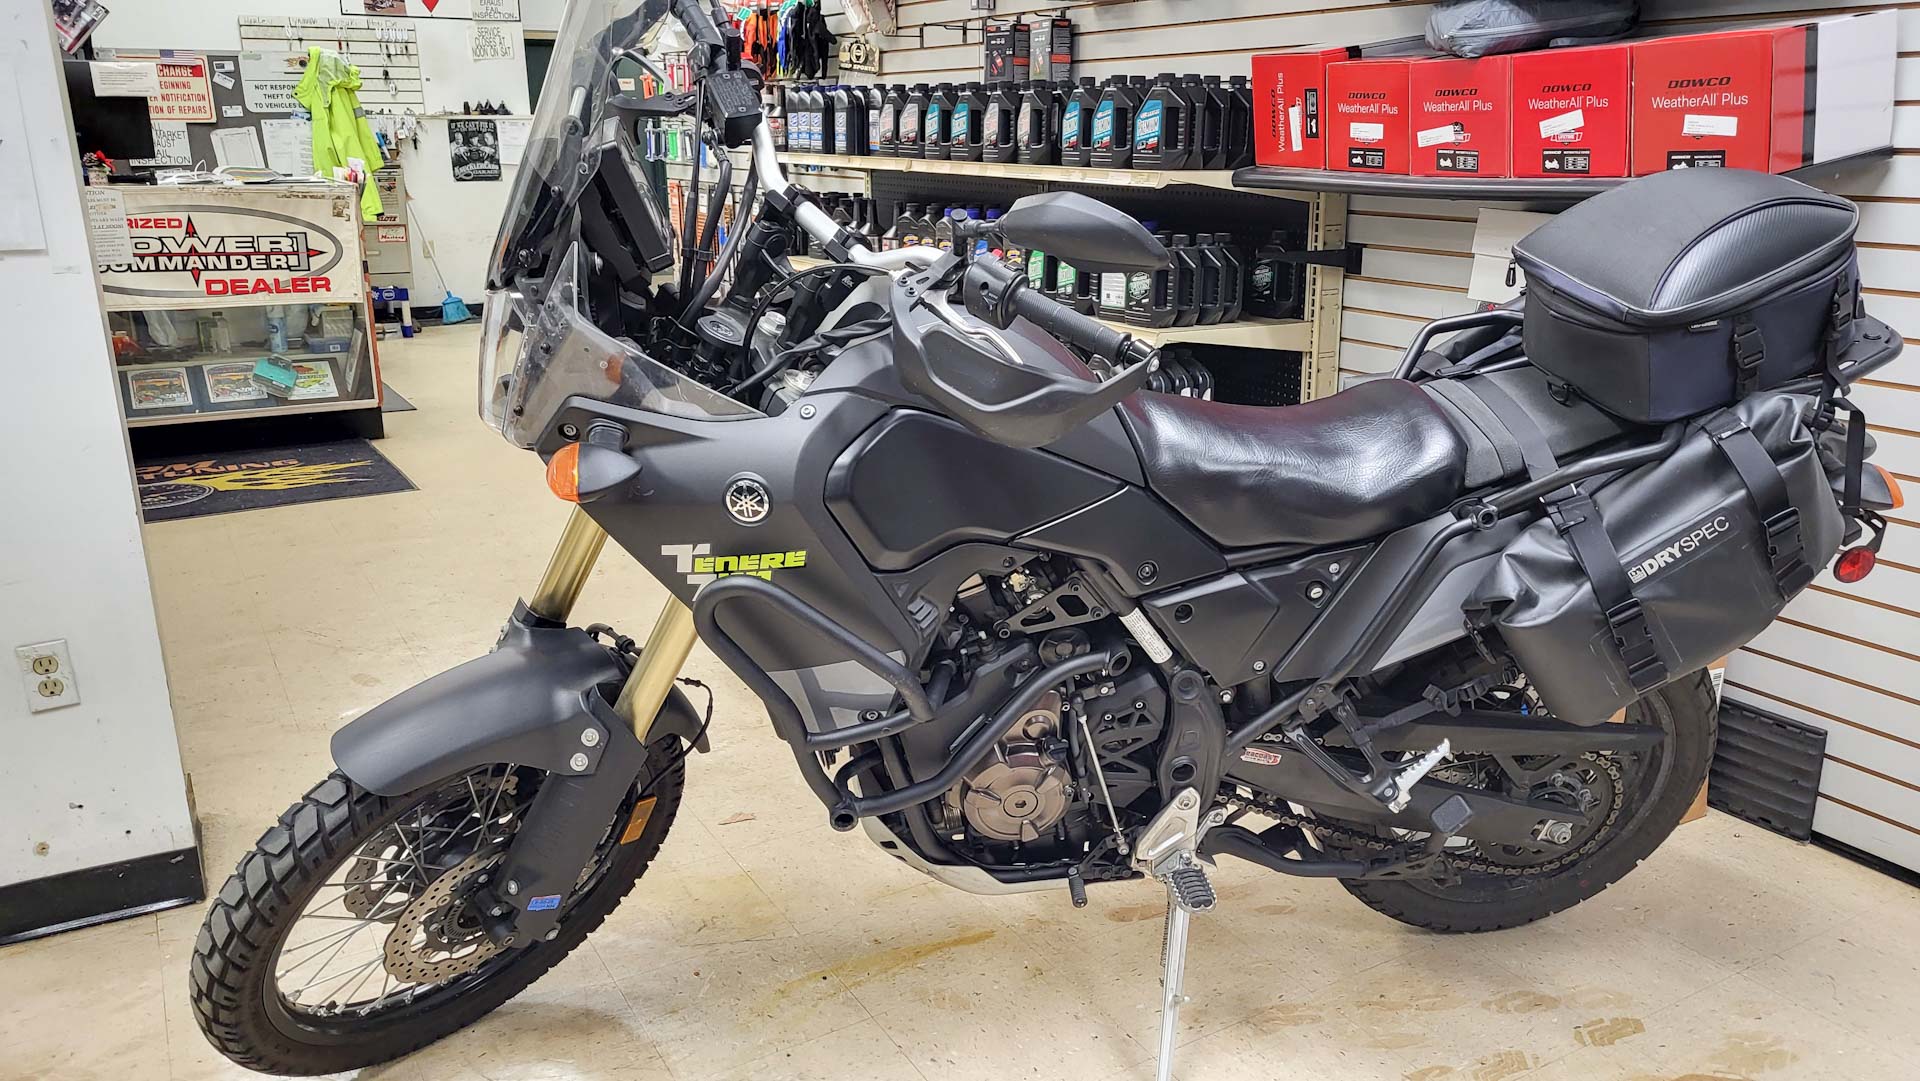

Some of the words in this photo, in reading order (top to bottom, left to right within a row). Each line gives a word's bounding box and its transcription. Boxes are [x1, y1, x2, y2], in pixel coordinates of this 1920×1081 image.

[158, 65, 193, 77] CHARGE
[160, 80, 192, 90] EGINNING
[1276, 72, 1284, 94] Plus
[1542, 83, 1592, 93] DOWCO
[1668, 76, 1731, 89] DOWCO
[161, 93, 207, 102] NOTIFICATION
[1434, 88, 1478, 97] DOWCO
[1423, 99, 1470, 112] WeatherAll
[1472, 99, 1493, 112] Plus
[1528, 95, 1582, 110] WeatherAll
[1586, 95, 1609, 108] Plus
[1651, 92, 1716, 109] WeatherAll
[1721, 92, 1749, 105] Plus
[149, 105, 164, 114] TION
[167, 105, 175, 114] OF
[178, 105, 208, 114] REPAIRS
[1337, 102, 1379, 114] WeatherAll
[1381, 103, 1399, 115] Plus
[1277, 98, 1286, 152] WeatherAll
[126, 217, 183, 229] RIZED
[130, 235, 292, 254] OWER
[205, 276, 332, 295] DEALER
[1641, 515, 1730, 576] DRYSPEC
